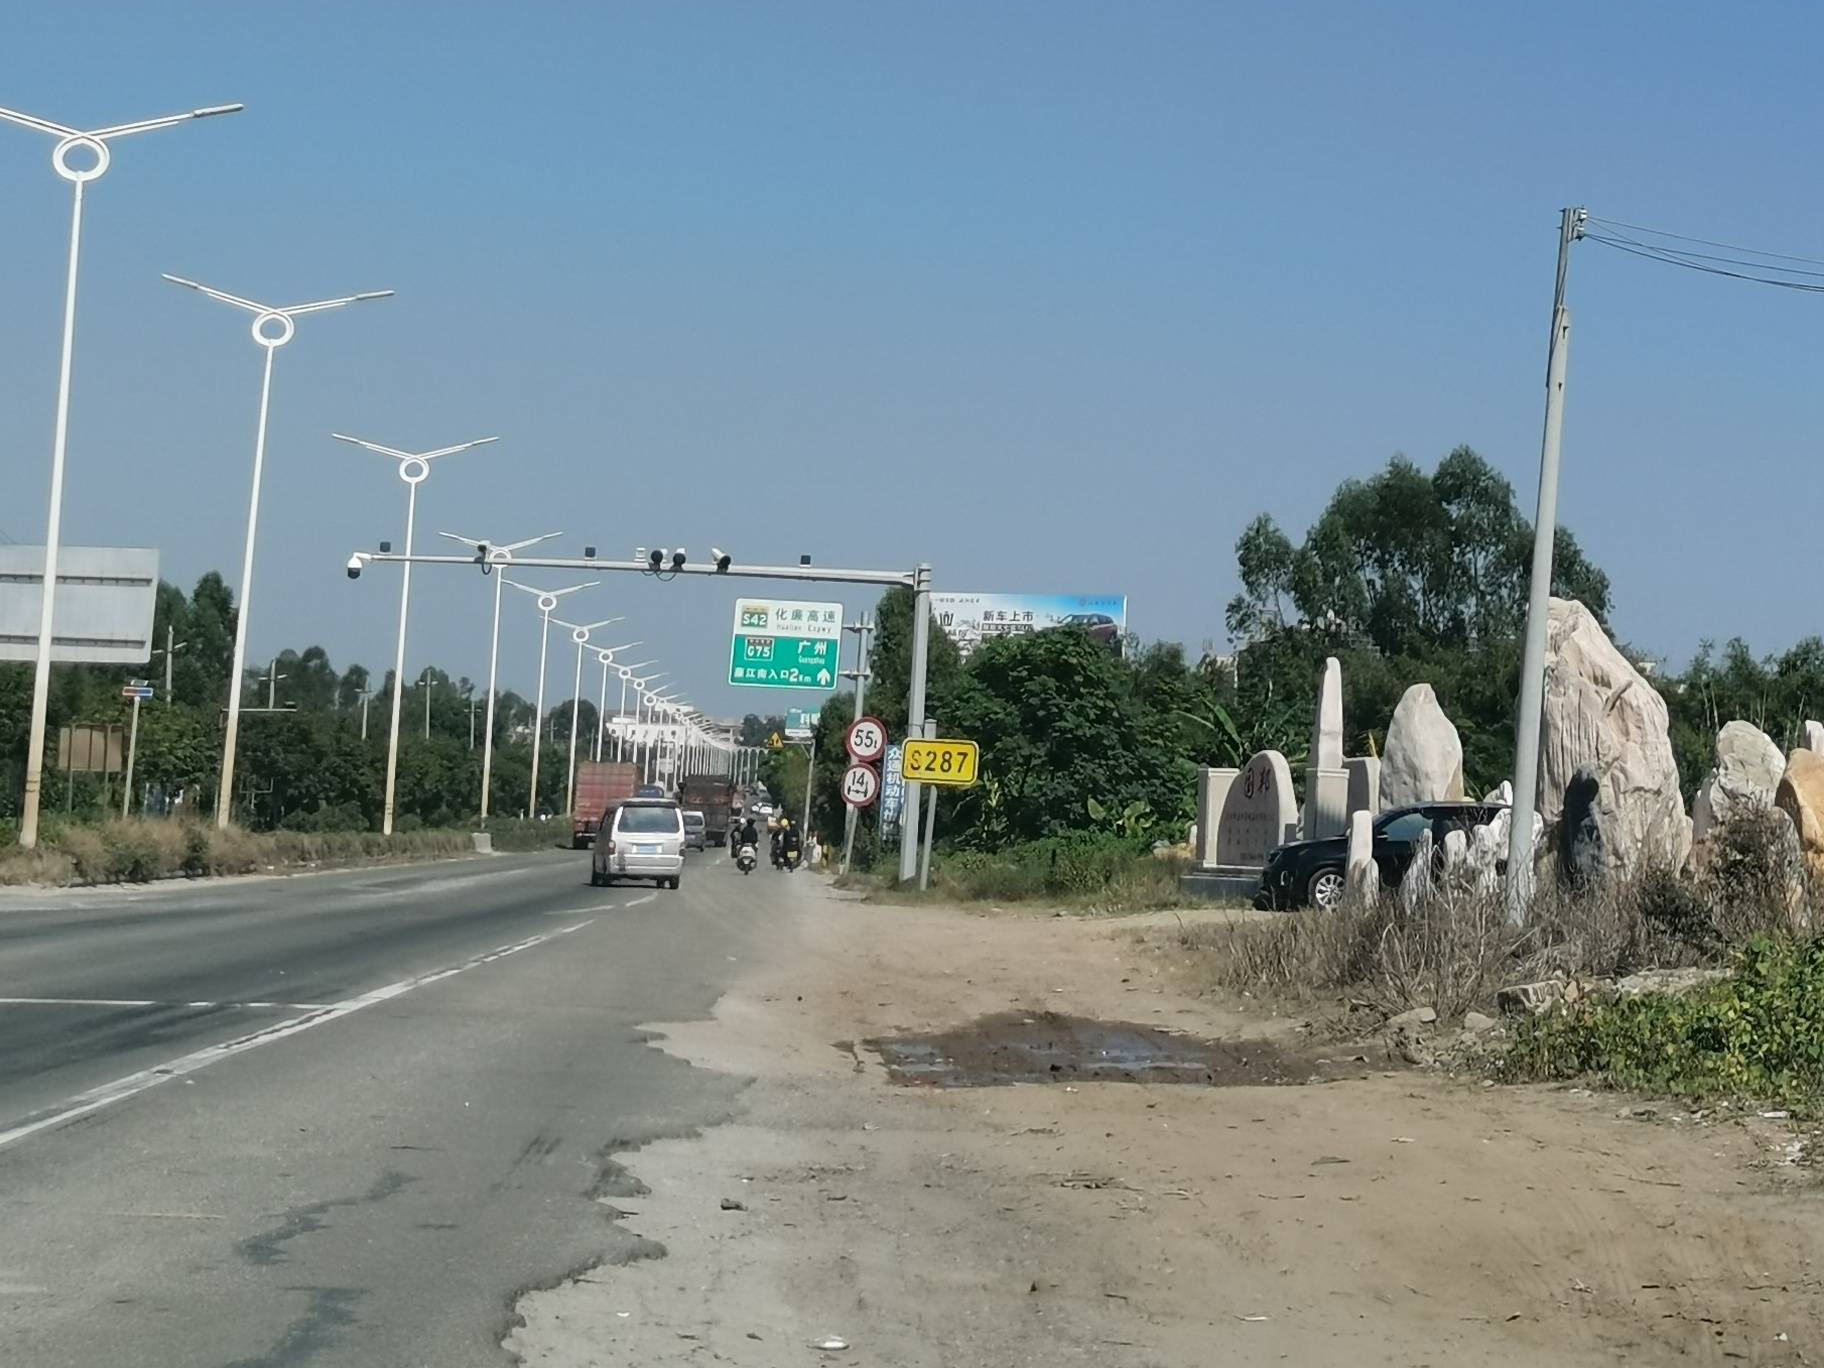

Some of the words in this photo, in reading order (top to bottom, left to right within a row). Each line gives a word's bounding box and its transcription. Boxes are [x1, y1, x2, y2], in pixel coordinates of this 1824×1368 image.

[743, 613, 767, 626] S42
[983, 610, 1034, 623] 新车上市
[747, 644, 771, 658] G75
[797, 640, 828, 656] 广州
[910, 749, 969, 774] S287
